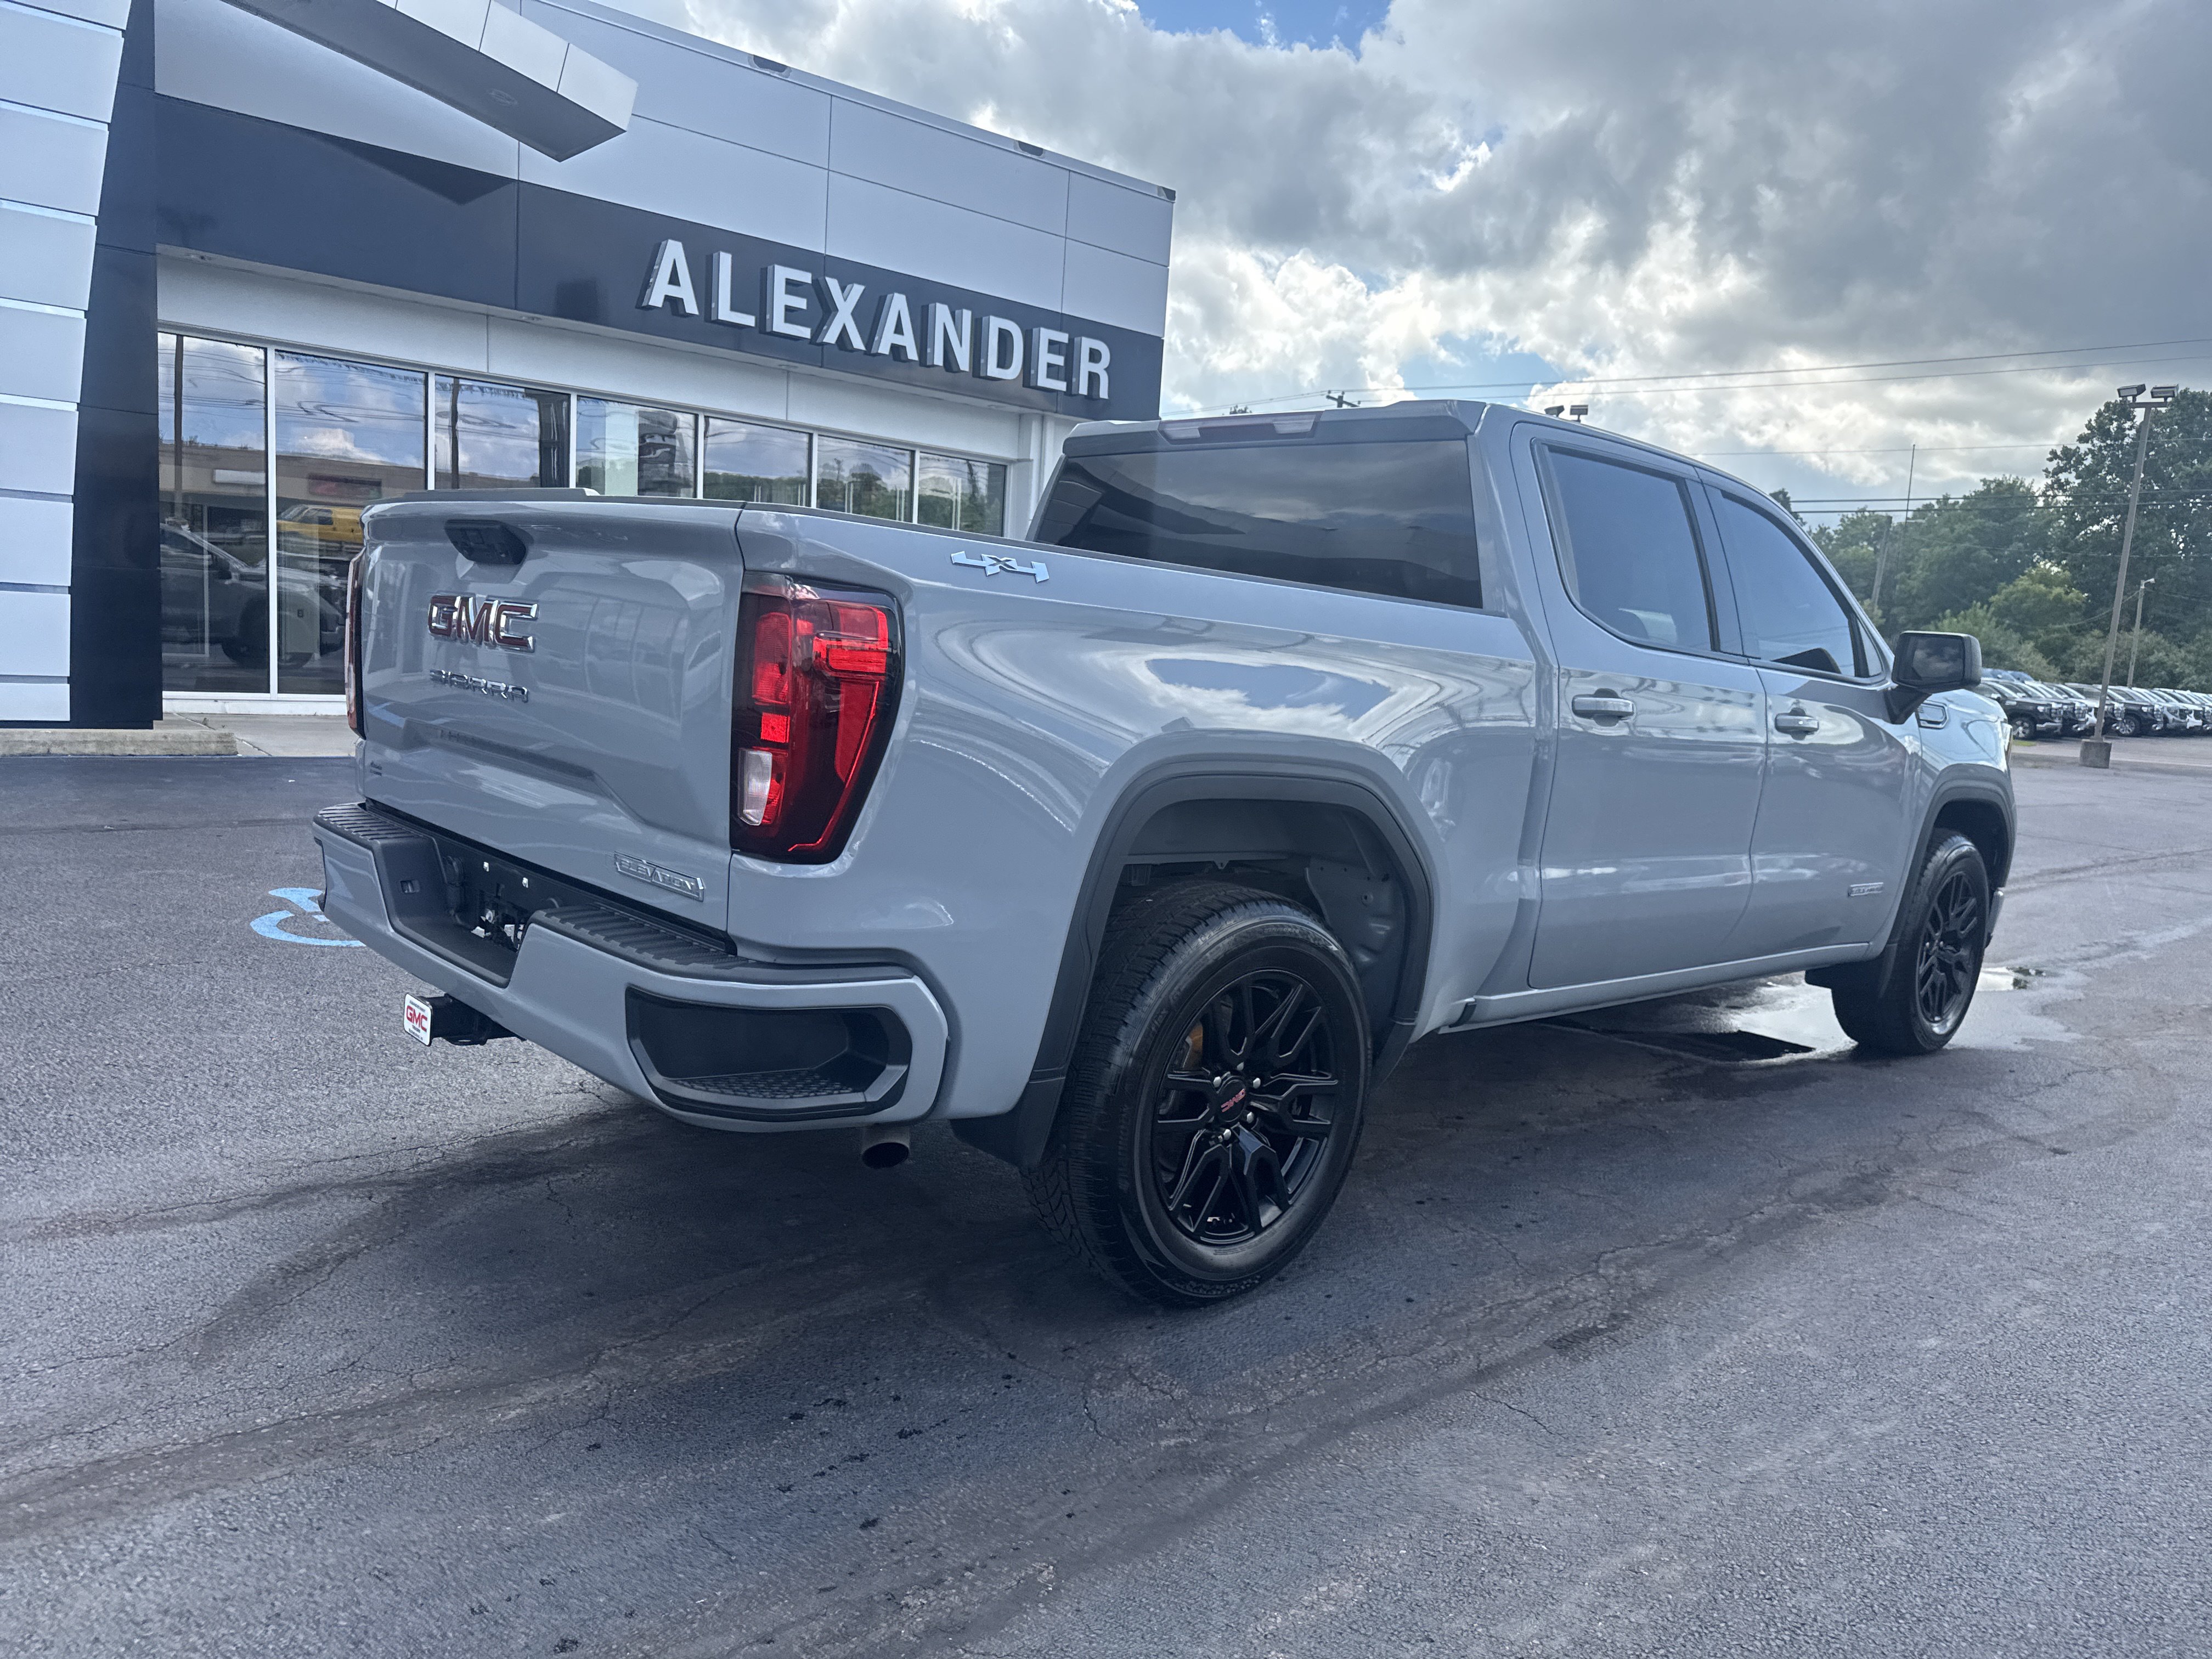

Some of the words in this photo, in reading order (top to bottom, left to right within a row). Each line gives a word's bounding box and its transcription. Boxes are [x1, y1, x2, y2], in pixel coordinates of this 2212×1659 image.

[642, 239, 1111, 399] ALEXANDER
[428, 595, 539, 653] GMC
[619, 857, 697, 893] ELEVATION
[406, 1005, 427, 1032] GMC
